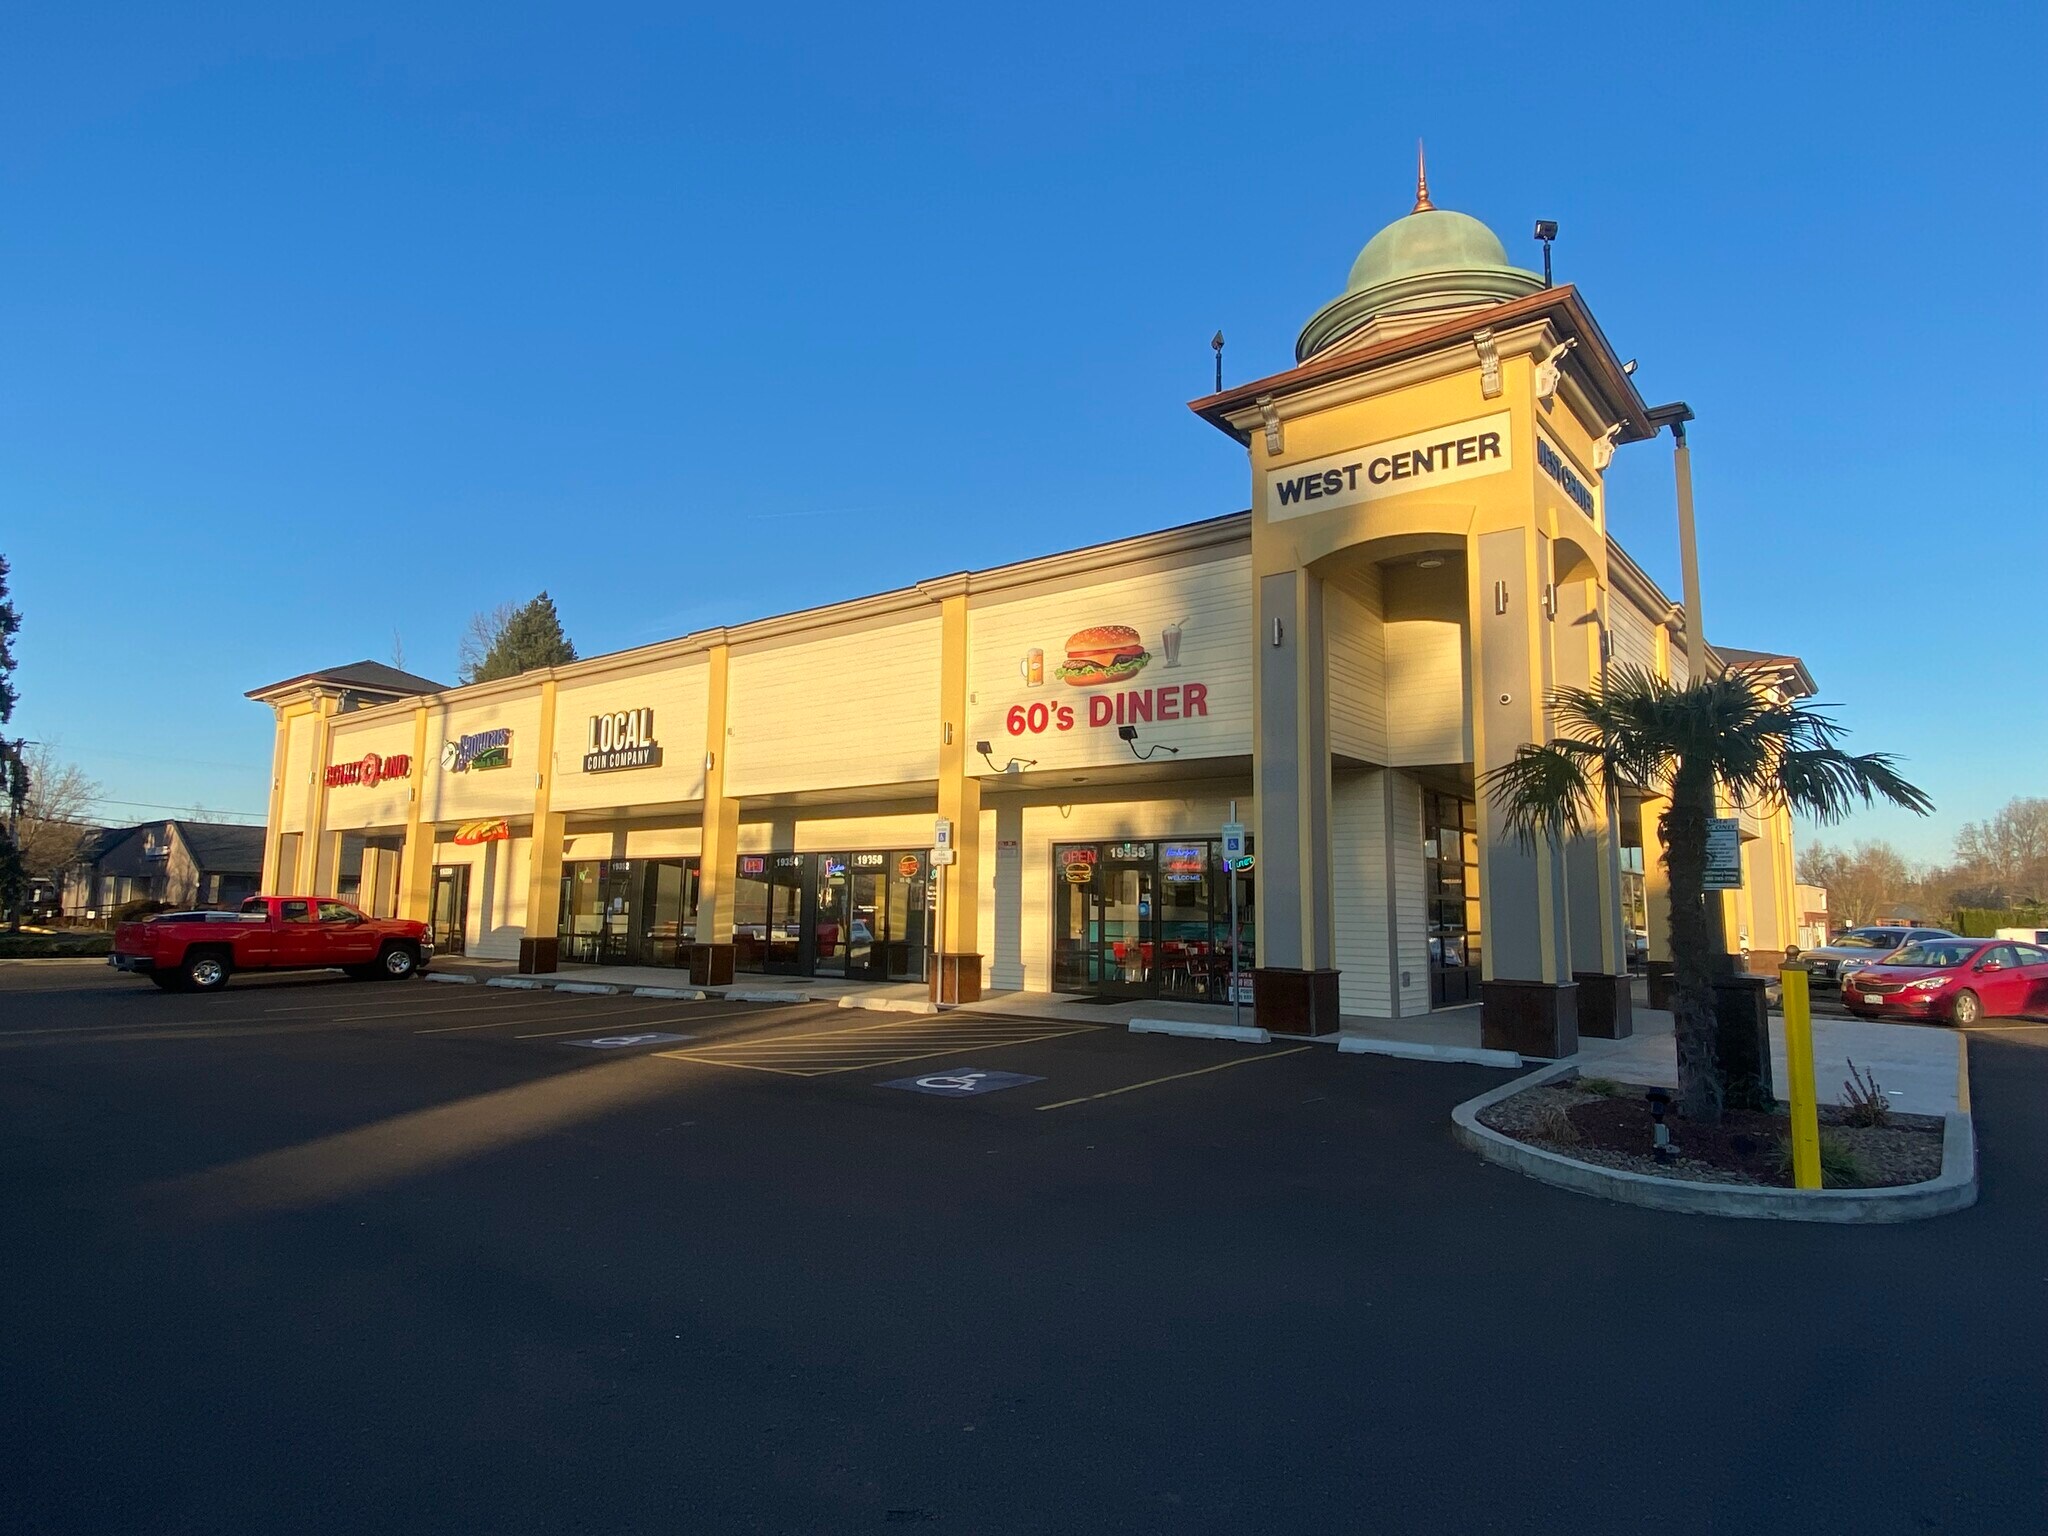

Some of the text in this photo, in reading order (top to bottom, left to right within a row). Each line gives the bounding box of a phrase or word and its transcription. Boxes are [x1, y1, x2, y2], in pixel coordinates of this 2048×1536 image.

[1276, 431, 1501, 506] WEST CENTER
[1562, 466, 1594, 521] CENTER
[589, 707, 653, 753] LOCAL
[1006, 682, 1208, 736] 60's DINER
[375, 753, 410, 780] LAND
[587, 749, 650, 770] COIN COMPANY
[1061, 849, 1098, 865] OPEN
